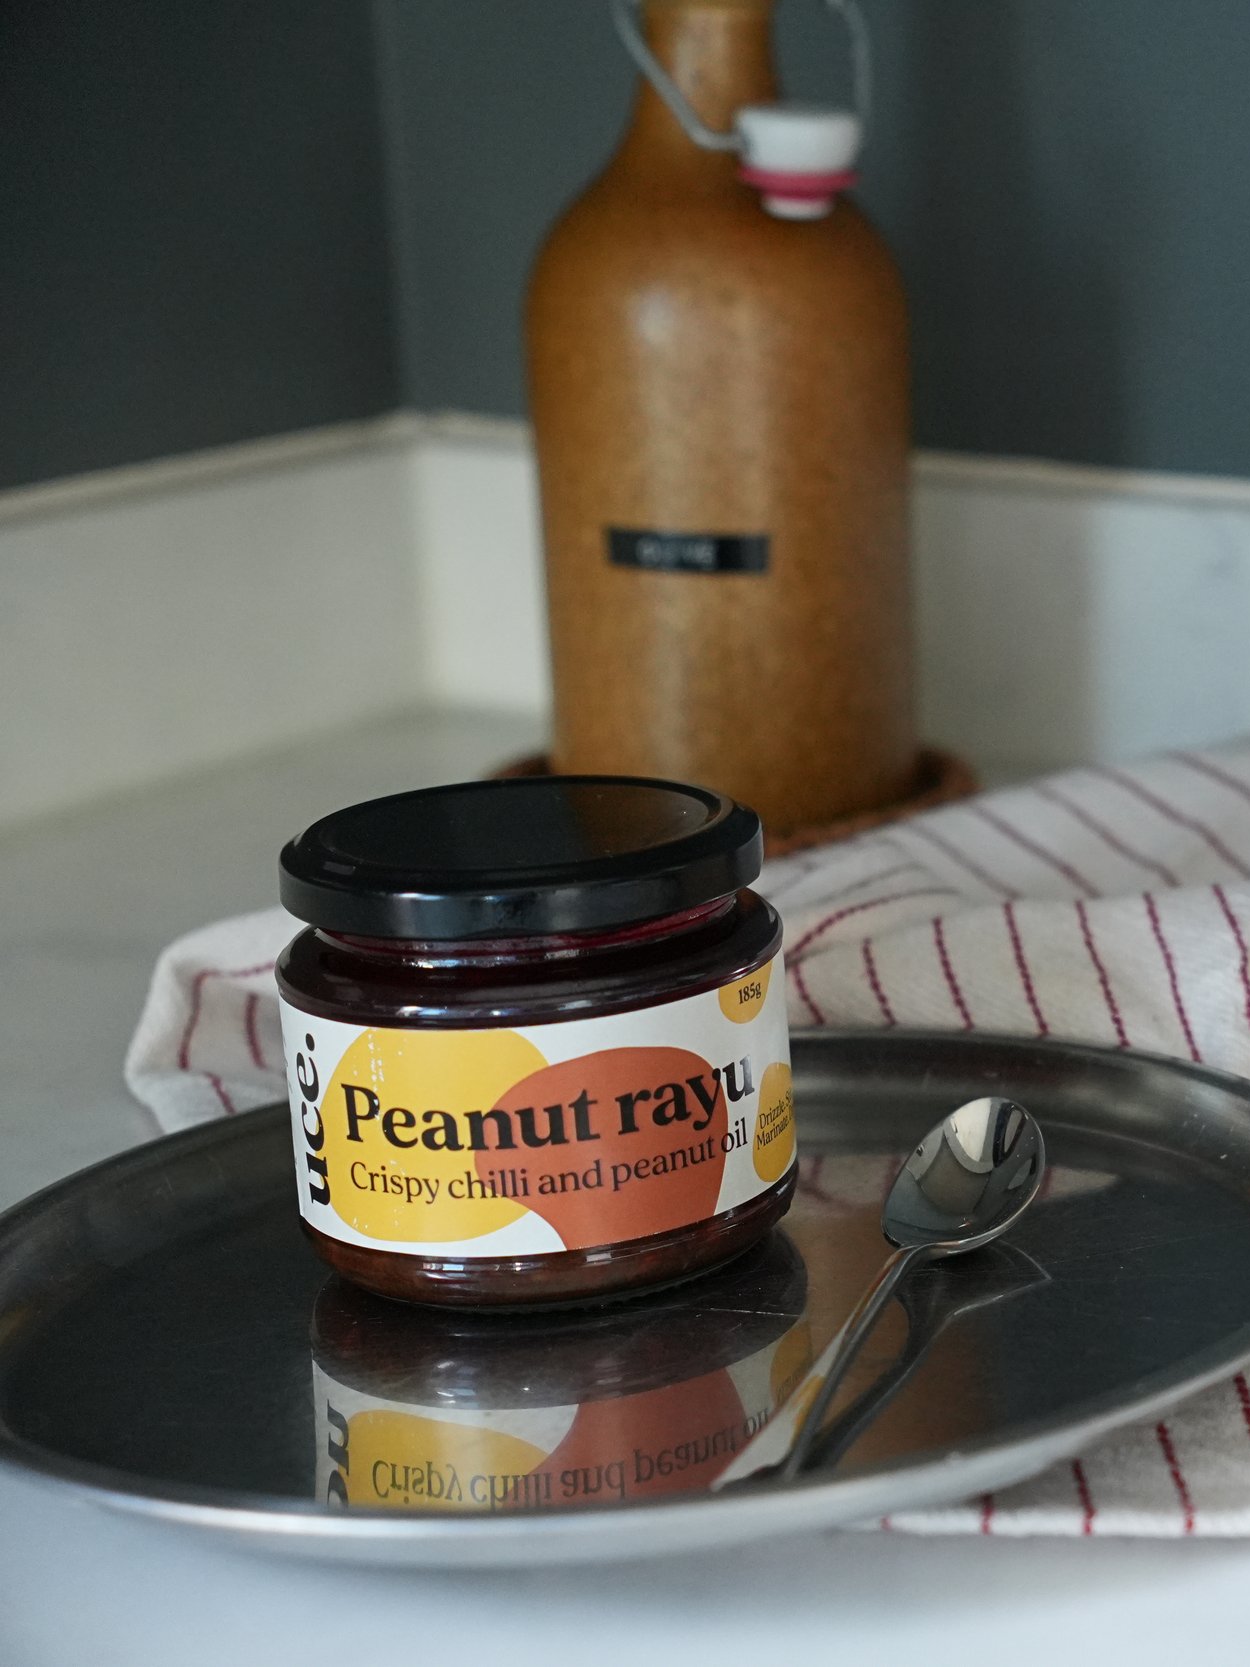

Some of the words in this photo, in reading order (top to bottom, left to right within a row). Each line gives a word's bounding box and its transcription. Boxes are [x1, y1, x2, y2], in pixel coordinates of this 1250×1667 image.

[738, 981, 762, 1005] 185g
[297, 1033, 331, 1205] uce.
[340, 1083, 600, 1152] Peanut
[615, 1054, 756, 1131] rayu
[350, 1161, 439, 1204] Crispy
[448, 1168, 529, 1200] chilli
[538, 1158, 604, 1195] and
[611, 1141, 717, 1191] peanut
[720, 1117, 749, 1154] oil
